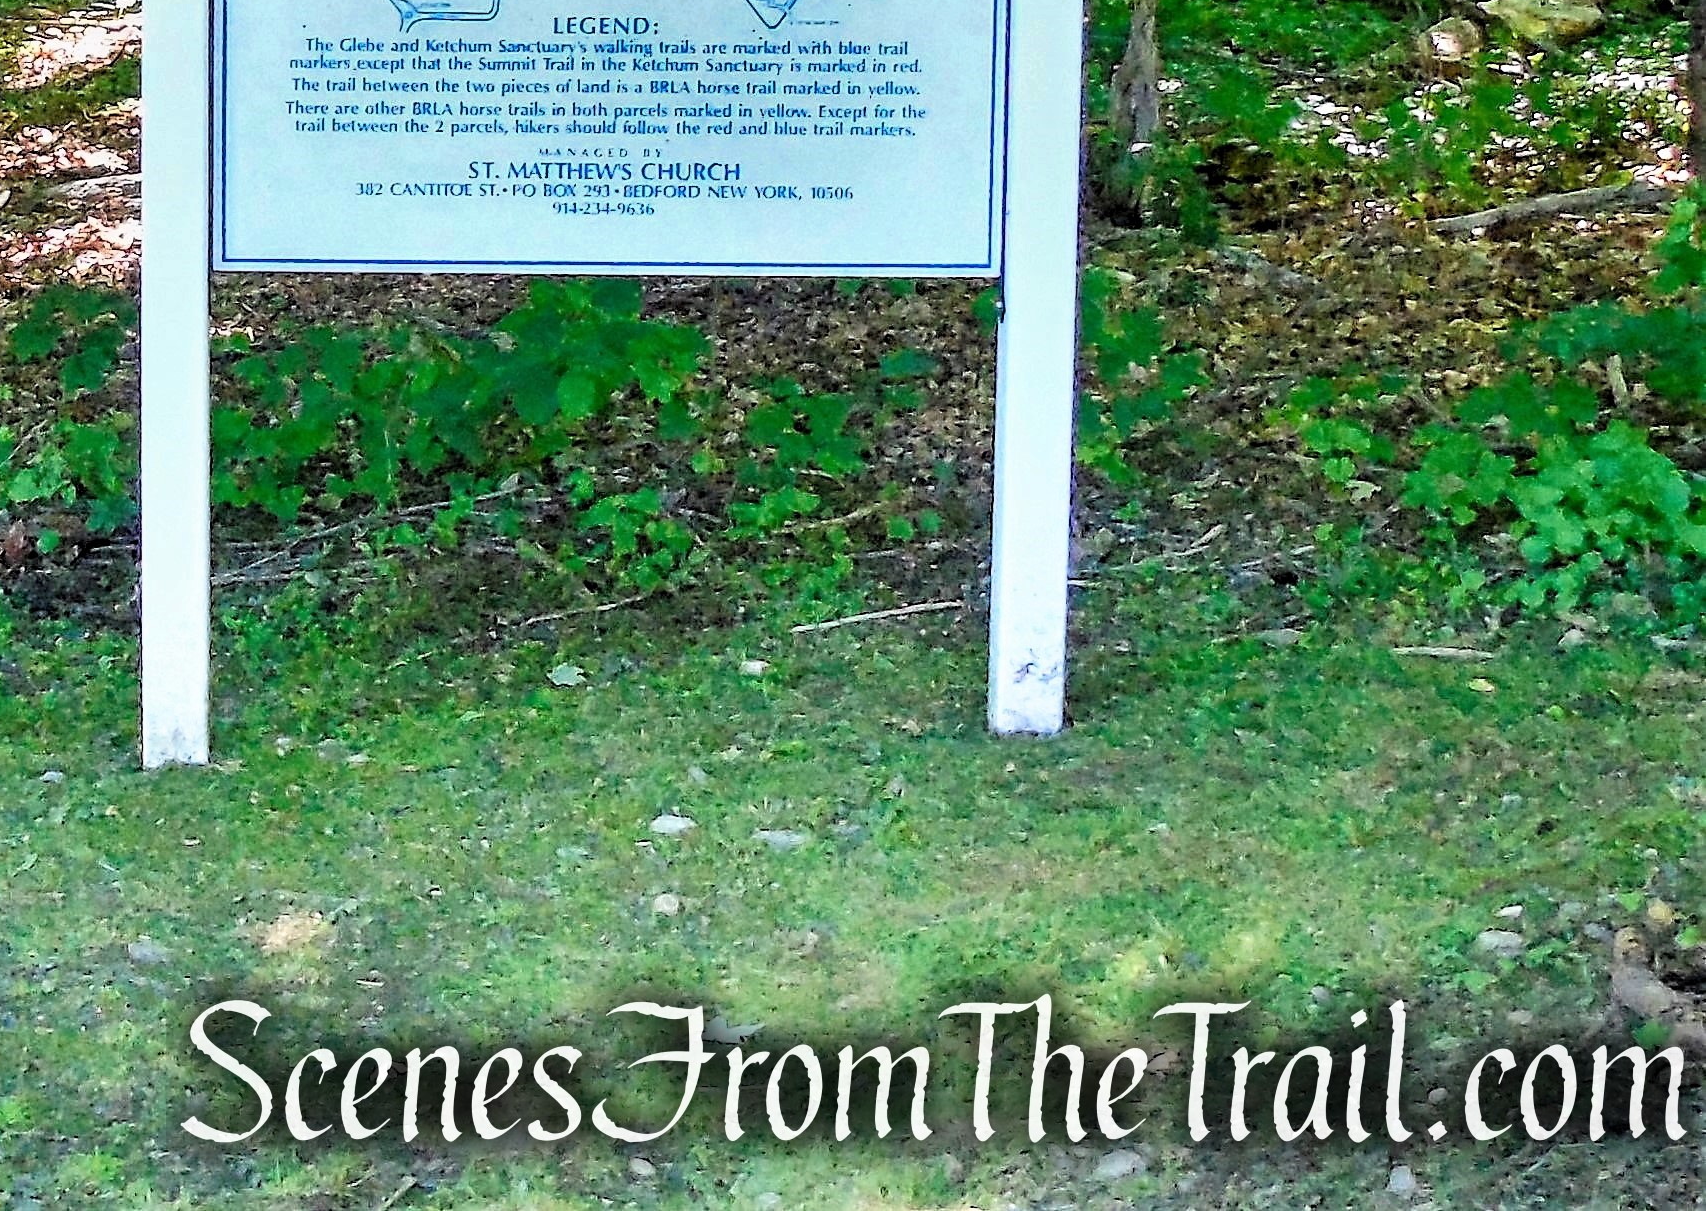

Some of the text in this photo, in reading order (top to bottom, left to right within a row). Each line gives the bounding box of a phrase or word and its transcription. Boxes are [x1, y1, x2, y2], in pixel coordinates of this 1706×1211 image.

[554, 17, 658, 34] LEGEND:
[292, 77, 319, 92] The
[327, 77, 355, 92] trail
[363, 78, 428, 92] between
[436, 78, 459, 92] the
[467, 81, 494, 93] two
[502, 78, 549, 97] pieces
[578, 79, 609, 93] land
[617, 79, 628, 93] is
[698, 79, 740, 94] horse
[747, 79, 776, 94] trail
[784, 80, 840, 94] marked
[848, 80, 861, 94] in
[286, 100, 328, 115] There
[333, 105, 359, 115] are
[365, 101, 405, 115] other
[460, 101, 502, 116] horse
[509, 102, 545, 116] trails
[552, 102, 565, 116] in
[573, 102, 607, 117] both
[614, 102, 667, 121] parcels
[675, 103, 731, 117] marked
[739, 103, 752, 117] in
[819, 104, 866, 122] Except
[875, 104, 895, 118] for
[903, 104, 925, 119] the
[296, 117, 324, 132] trail
[332, 118, 397, 132] between
[405, 118, 429, 132] the
[436, 118, 443, 133] 2
[513, 119, 559, 133] hikers
[566, 119, 616, 134] should
[624, 120, 667, 134] follow
[677, 120, 700, 134] the
[708, 120, 732, 135] red
[739, 121, 767, 135] and
[774, 121, 807, 135] blue
[814, 121, 843, 135] trail
[469, 162, 740, 181] ST. MATTHEW'S CHURCH
[390, 184, 472, 197] CANTITOE
[544, 185, 577, 198] BOX
[708, 186, 747, 199] NEW
[755, 186, 802, 200] YORK,
[811, 187, 853, 200] 10506
